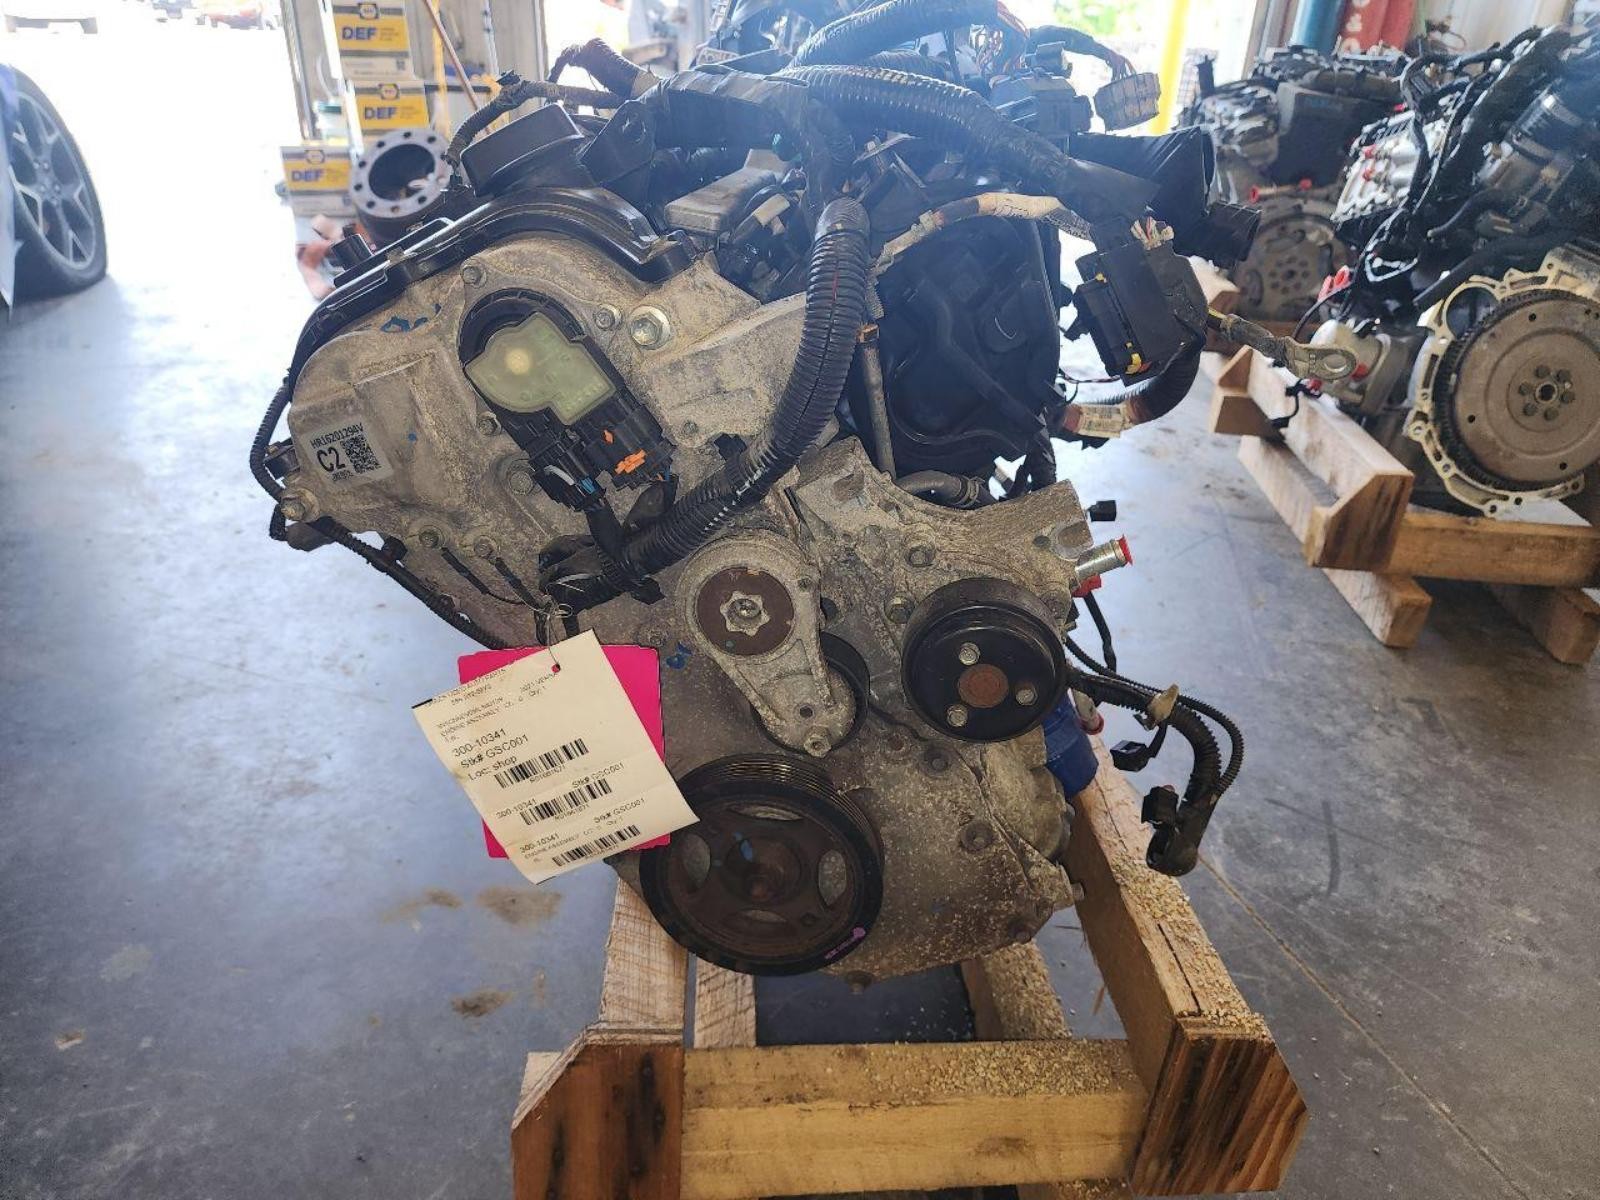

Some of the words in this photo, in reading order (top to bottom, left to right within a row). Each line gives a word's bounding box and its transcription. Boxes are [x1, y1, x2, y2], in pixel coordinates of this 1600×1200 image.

[342, 27, 377, 40] DEF
[364, 107, 398, 120] DEF
[291, 169, 324, 181] DEF
[317, 447, 345, 472] C2
[451, 728, 508, 757] 300-10341
[459, 753, 485, 769] Stk#
[483, 733, 529, 758] GSC001
[490, 754, 518, 771] shop
[611, 798, 645, 815] GSC001
